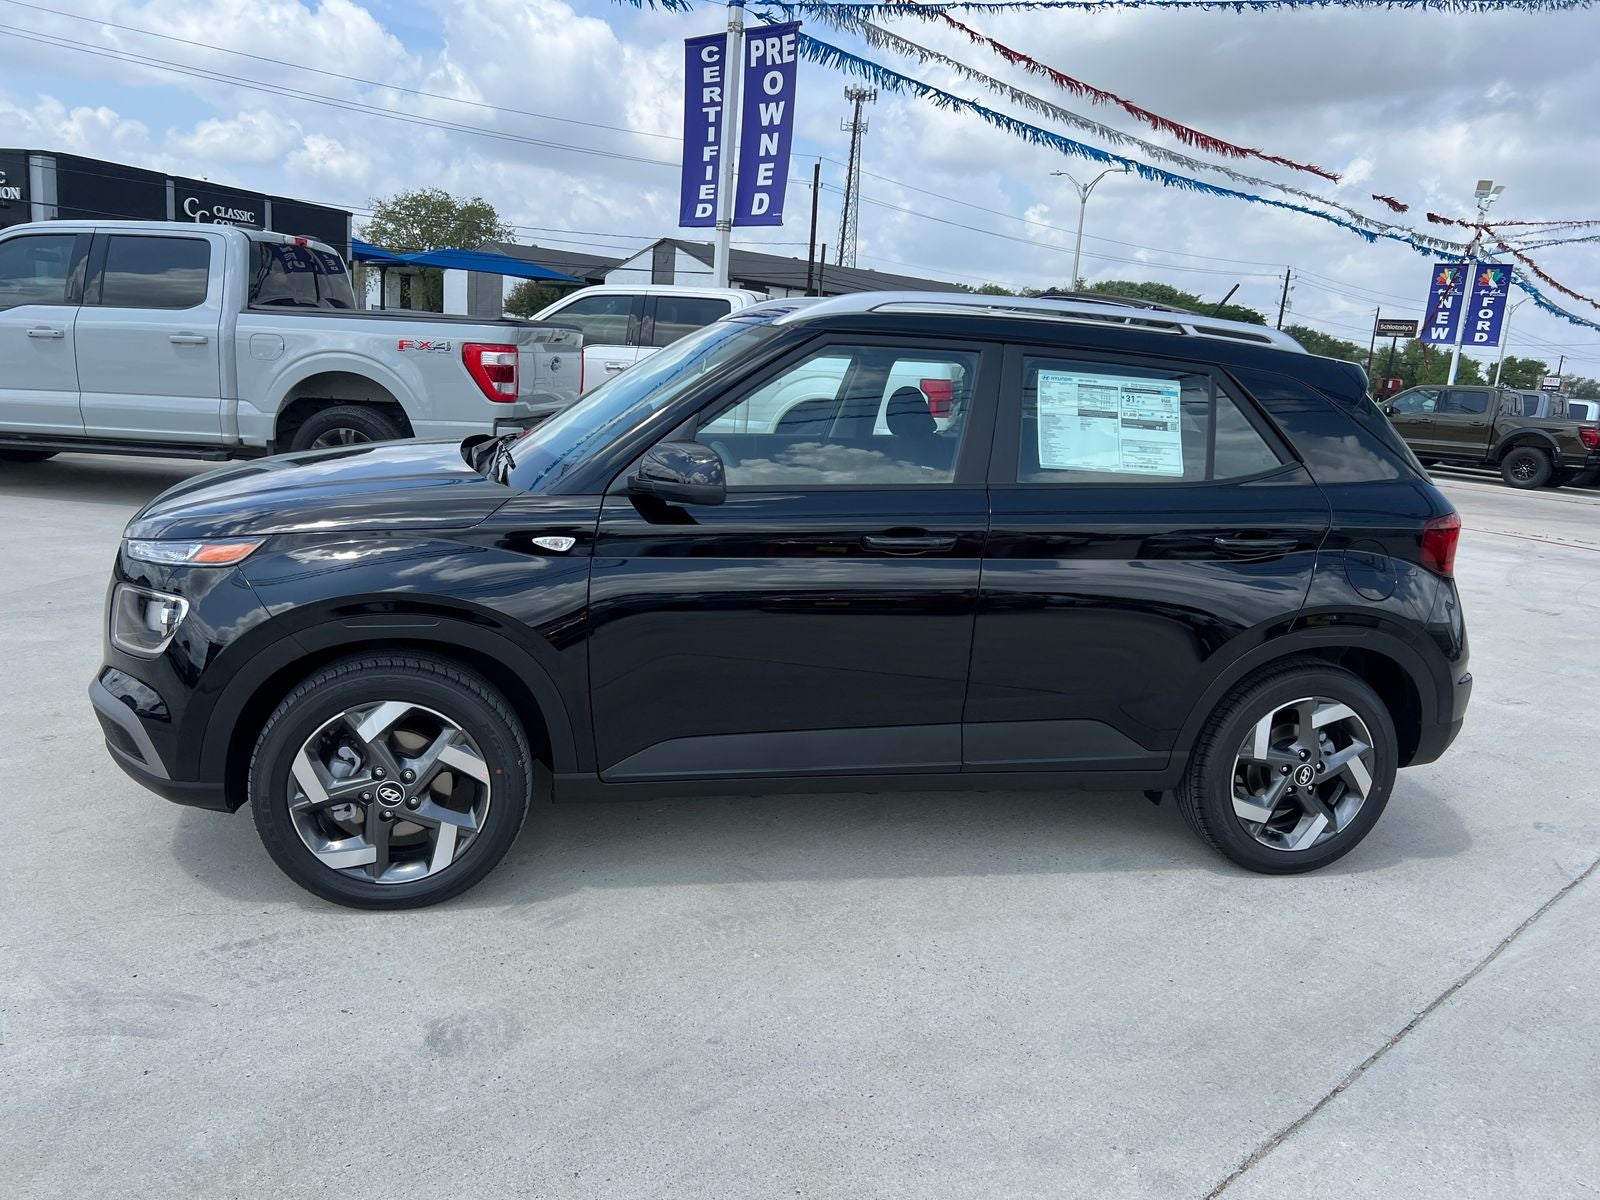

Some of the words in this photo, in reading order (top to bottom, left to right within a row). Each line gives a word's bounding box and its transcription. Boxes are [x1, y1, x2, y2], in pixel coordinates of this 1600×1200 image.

[750, 33, 796, 68] PRE
[694, 45, 722, 218] CERTIFIED
[751, 70, 785, 216] OWNED
[213, 205, 255, 223] CLASSIC
[1431, 296, 1453, 340] NEW
[1473, 297, 1495, 343] FORD
[397, 339, 452, 352] FX4
[1125, 394, 1135, 402] 31
